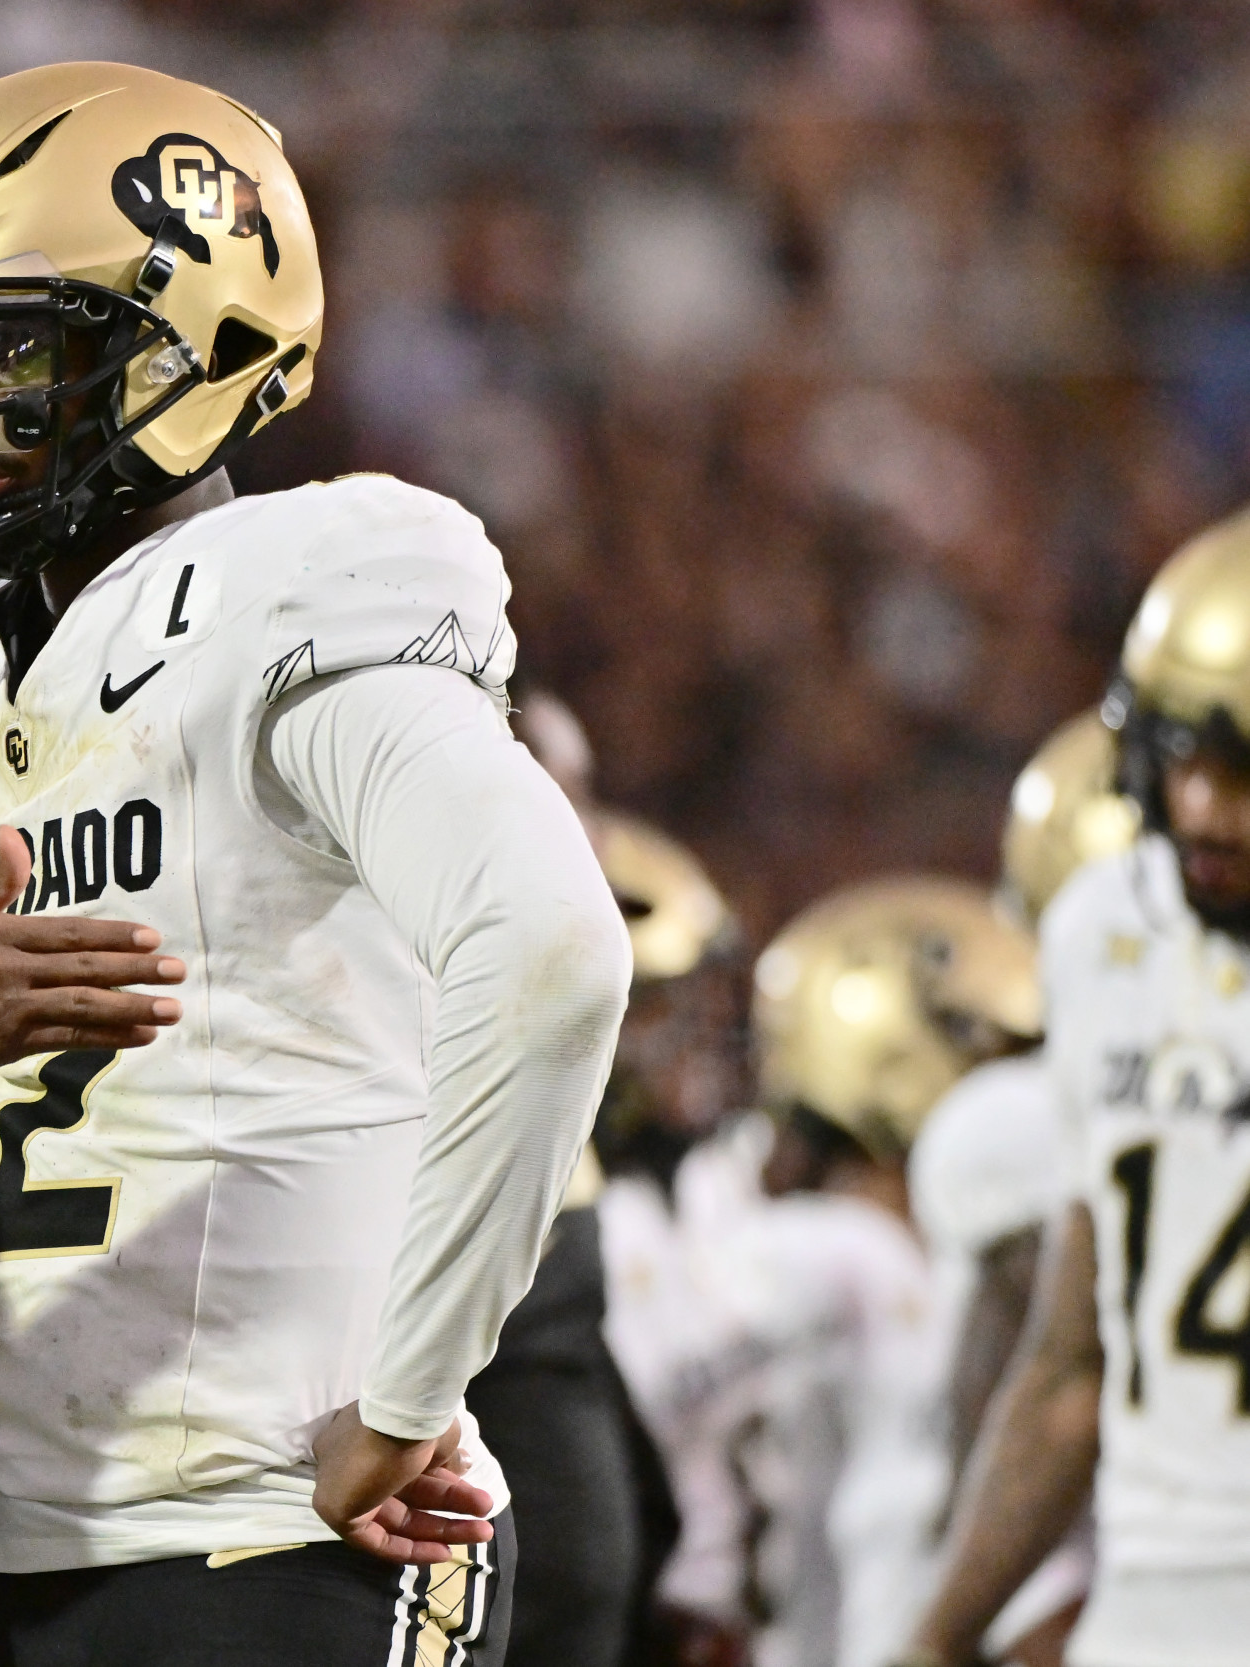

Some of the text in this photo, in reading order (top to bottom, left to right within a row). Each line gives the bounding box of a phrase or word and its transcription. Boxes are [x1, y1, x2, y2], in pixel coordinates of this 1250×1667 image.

[159, 145, 236, 236] CU
[5, 726, 30, 778] CU
[1110, 1138, 1250, 1416] 14
